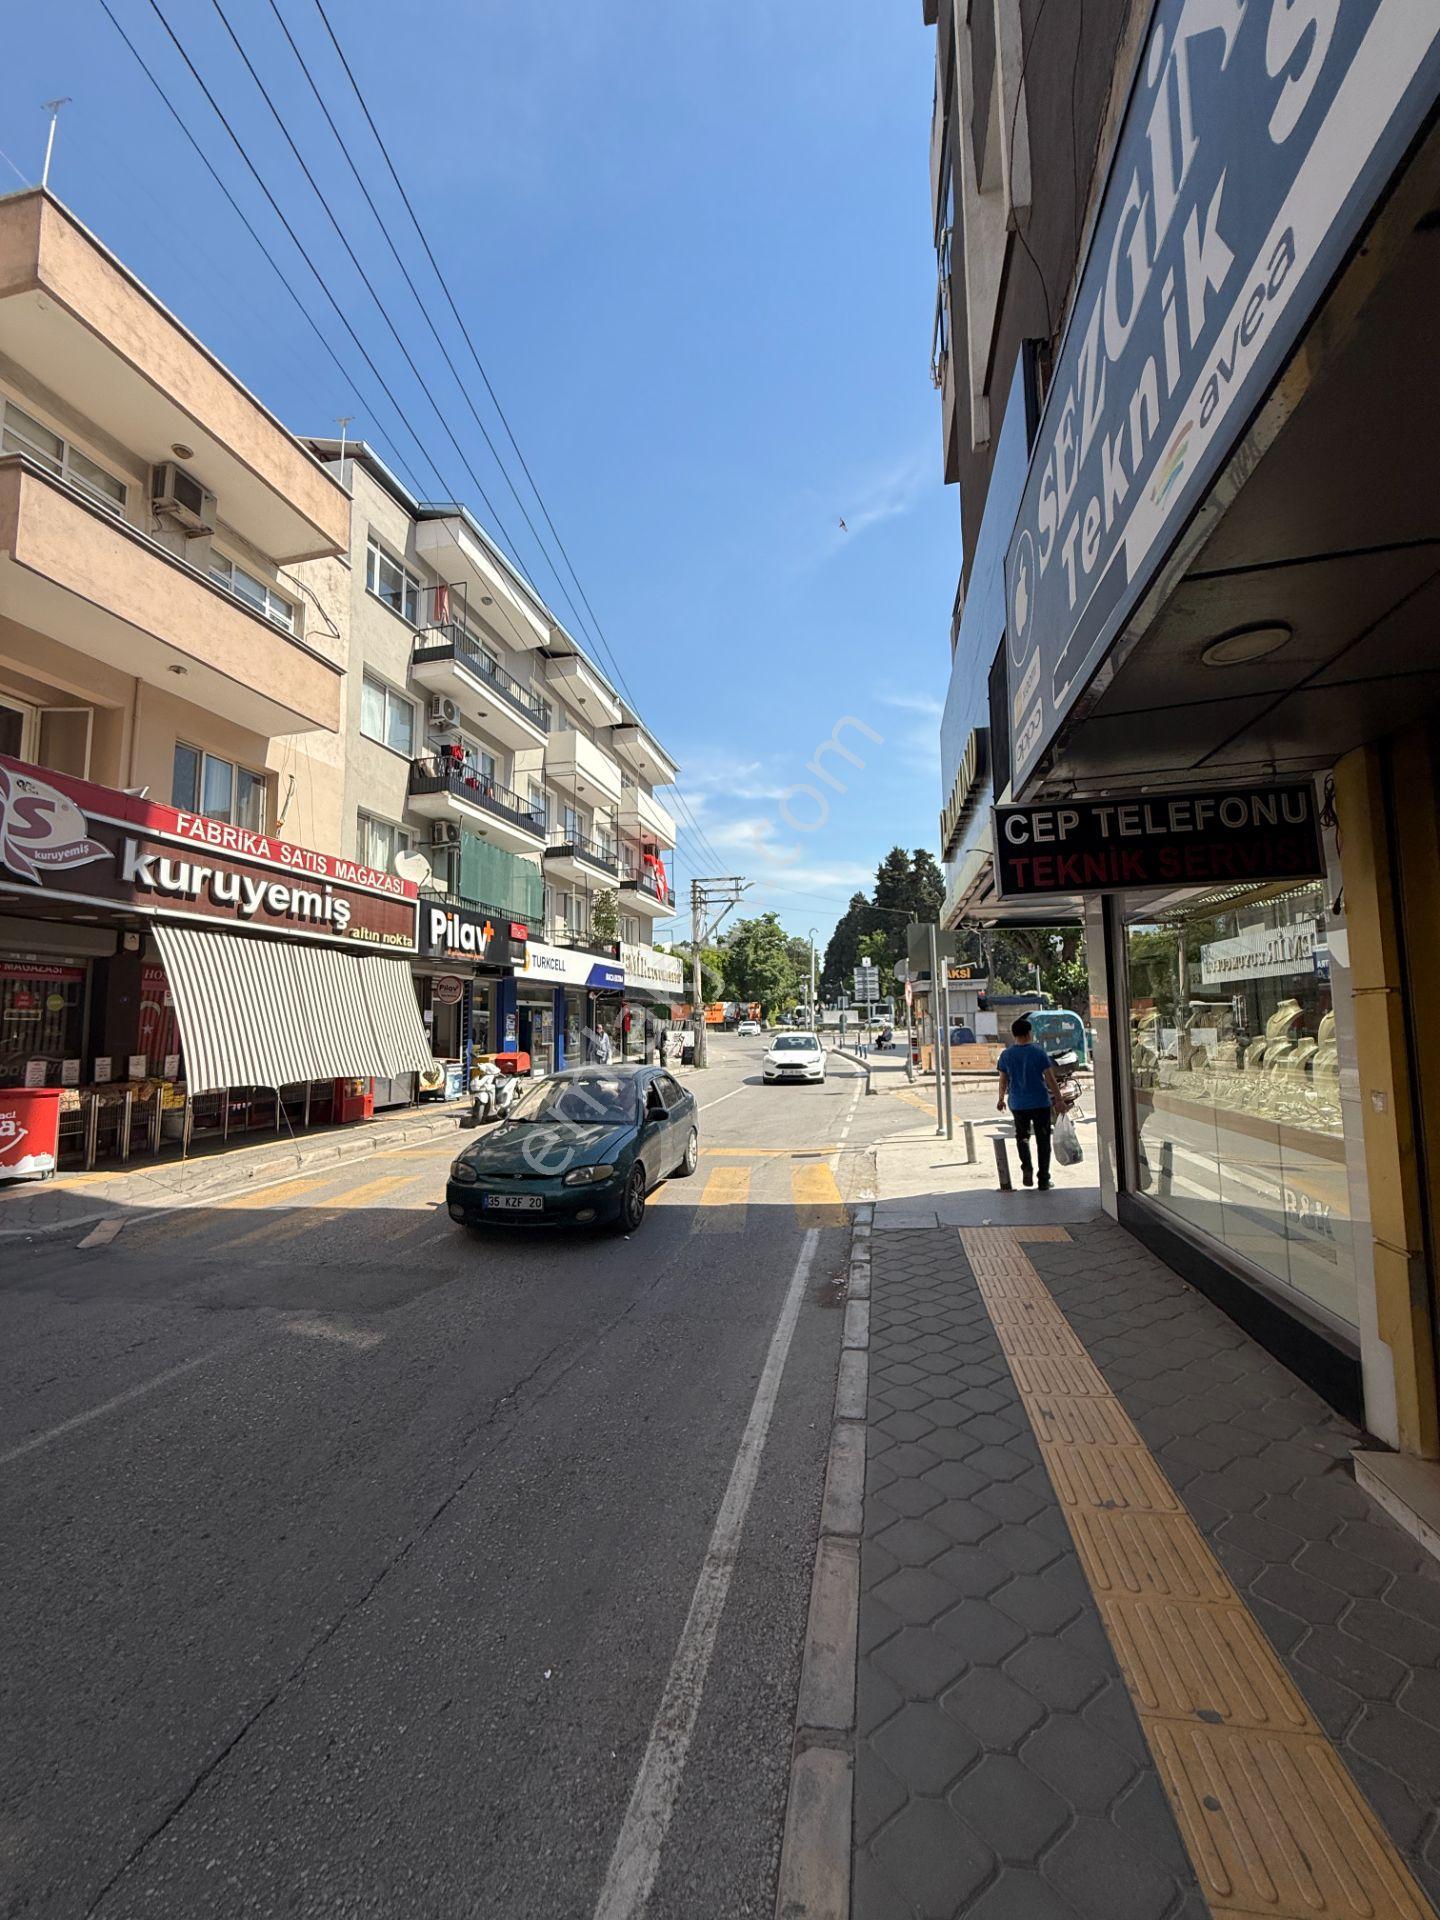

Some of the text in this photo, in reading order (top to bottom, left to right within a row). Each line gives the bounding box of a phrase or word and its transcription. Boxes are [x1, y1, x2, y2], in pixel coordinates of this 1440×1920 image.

[1200, 226, 1296, 429] avea
[1062, 162, 1235, 610] Teknik
[1004, 792, 1307, 845] CEP TELEFONU
[34, 844, 89, 861] kuruyemiş
[1008, 845, 1148, 888] TEKNİK
[122, 837, 351, 930] kuruyemiş
[335, 860, 404, 895] MAĞAZASI
[382, 933, 413, 948] nokta
[532, 954, 566, 972] TURKCELL
[488, 1196, 542, 1208] 35 KZF 20
